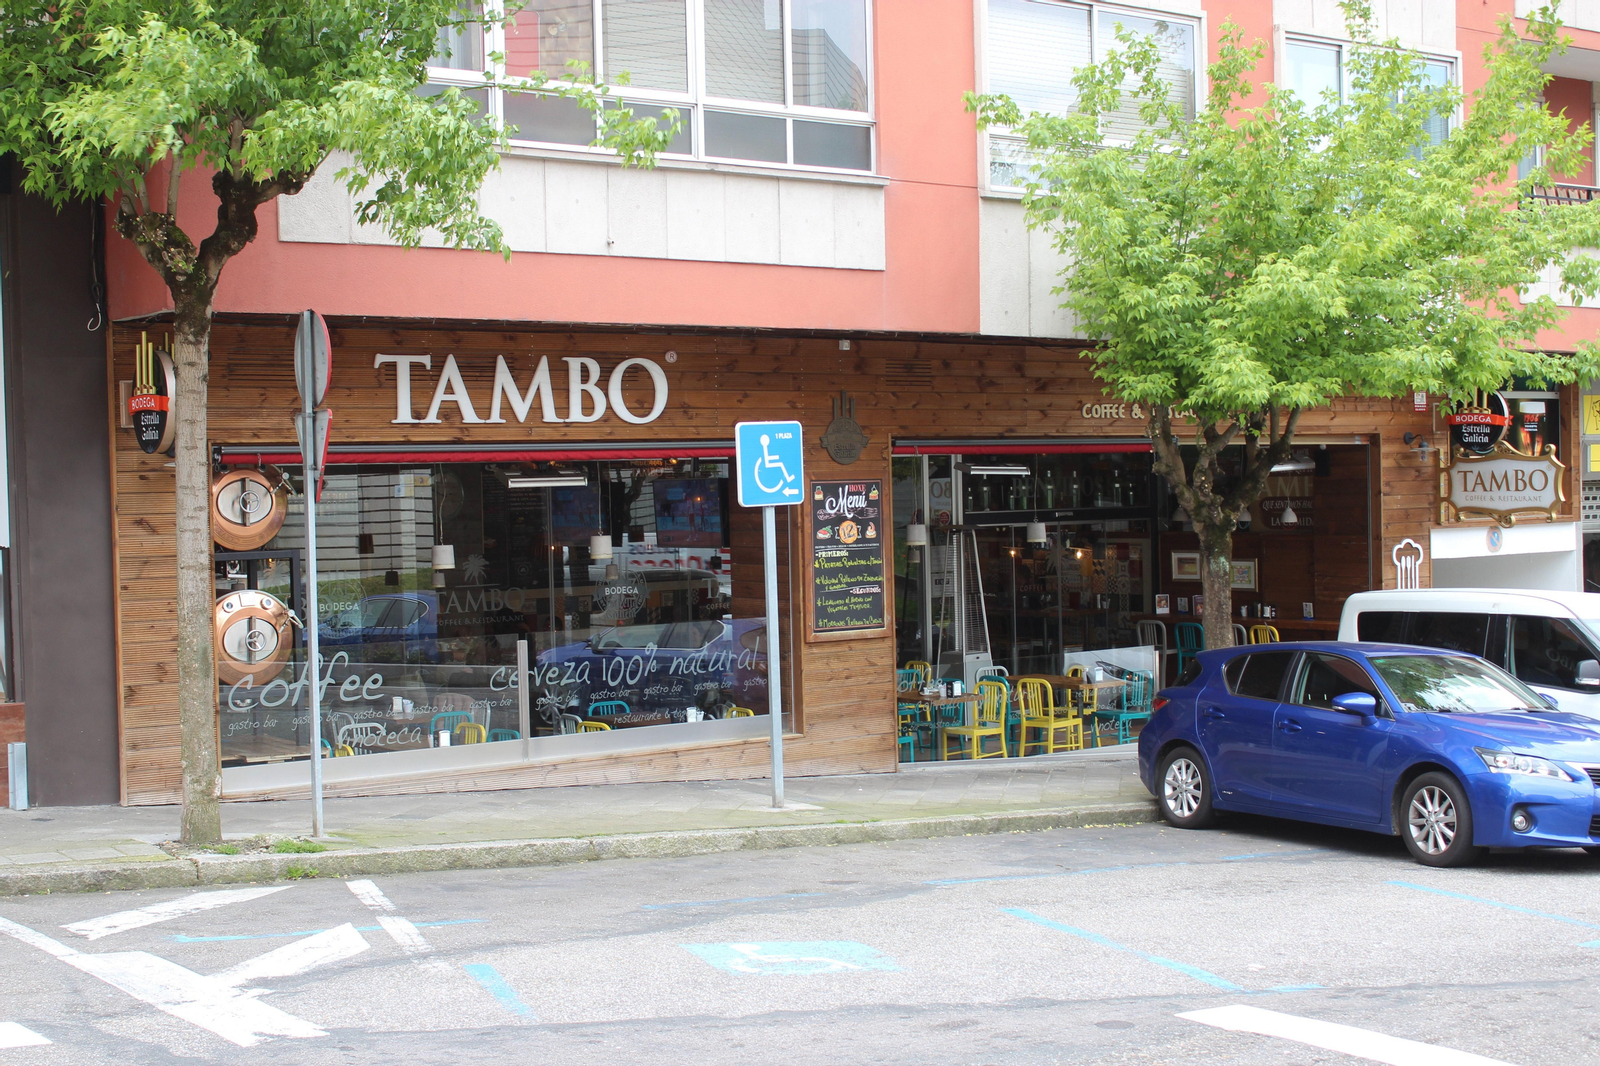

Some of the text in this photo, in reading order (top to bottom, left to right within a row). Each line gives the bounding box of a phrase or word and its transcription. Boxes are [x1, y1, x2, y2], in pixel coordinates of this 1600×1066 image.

[373, 353, 669, 424] TAMBO
[131, 396, 156, 410] BODEGA
[1082, 403, 1126, 418] COFFEE
[1131, 403, 1145, 419] &
[1455, 414, 1492, 424] BODEGA
[1461, 424, 1491, 434] Estrella
[1462, 433, 1489, 443] Galicia
[1457, 469, 1549, 493] TAMBO
[848, 484, 867, 492] HOXE
[825, 484, 868, 518] Menú
[1464, 494, 1487, 502] COFFEE
[1489, 494, 1495, 502] &
[604, 585, 640, 596] BODEGA
[435, 586, 526, 615] TAMBO
[706, 601, 731, 611] COFFEE
[319, 602, 360, 613] BODEGA
[472, 614, 525, 625] RESTAURANT
[602, 641, 658, 688] 100%
[668, 635, 760, 676] natural
[227, 718, 260, 737] gastro
[263, 715, 279, 728] bar
[325, 708, 340, 722] bar
[353, 707, 383, 725] gastro
[441, 699, 455, 711] bar
[499, 694, 513, 707] bar
[589, 688, 617, 706] gastro
[618, 685, 632, 698] bar
[643, 683, 669, 700] gastro
[671, 680, 684, 694] bar
[693, 679, 719, 696] gastro
[720, 677, 733, 690] bar
[742, 675, 767, 692] gastro
[613, 709, 662, 724] restaurante
[664, 707, 671, 719] &
